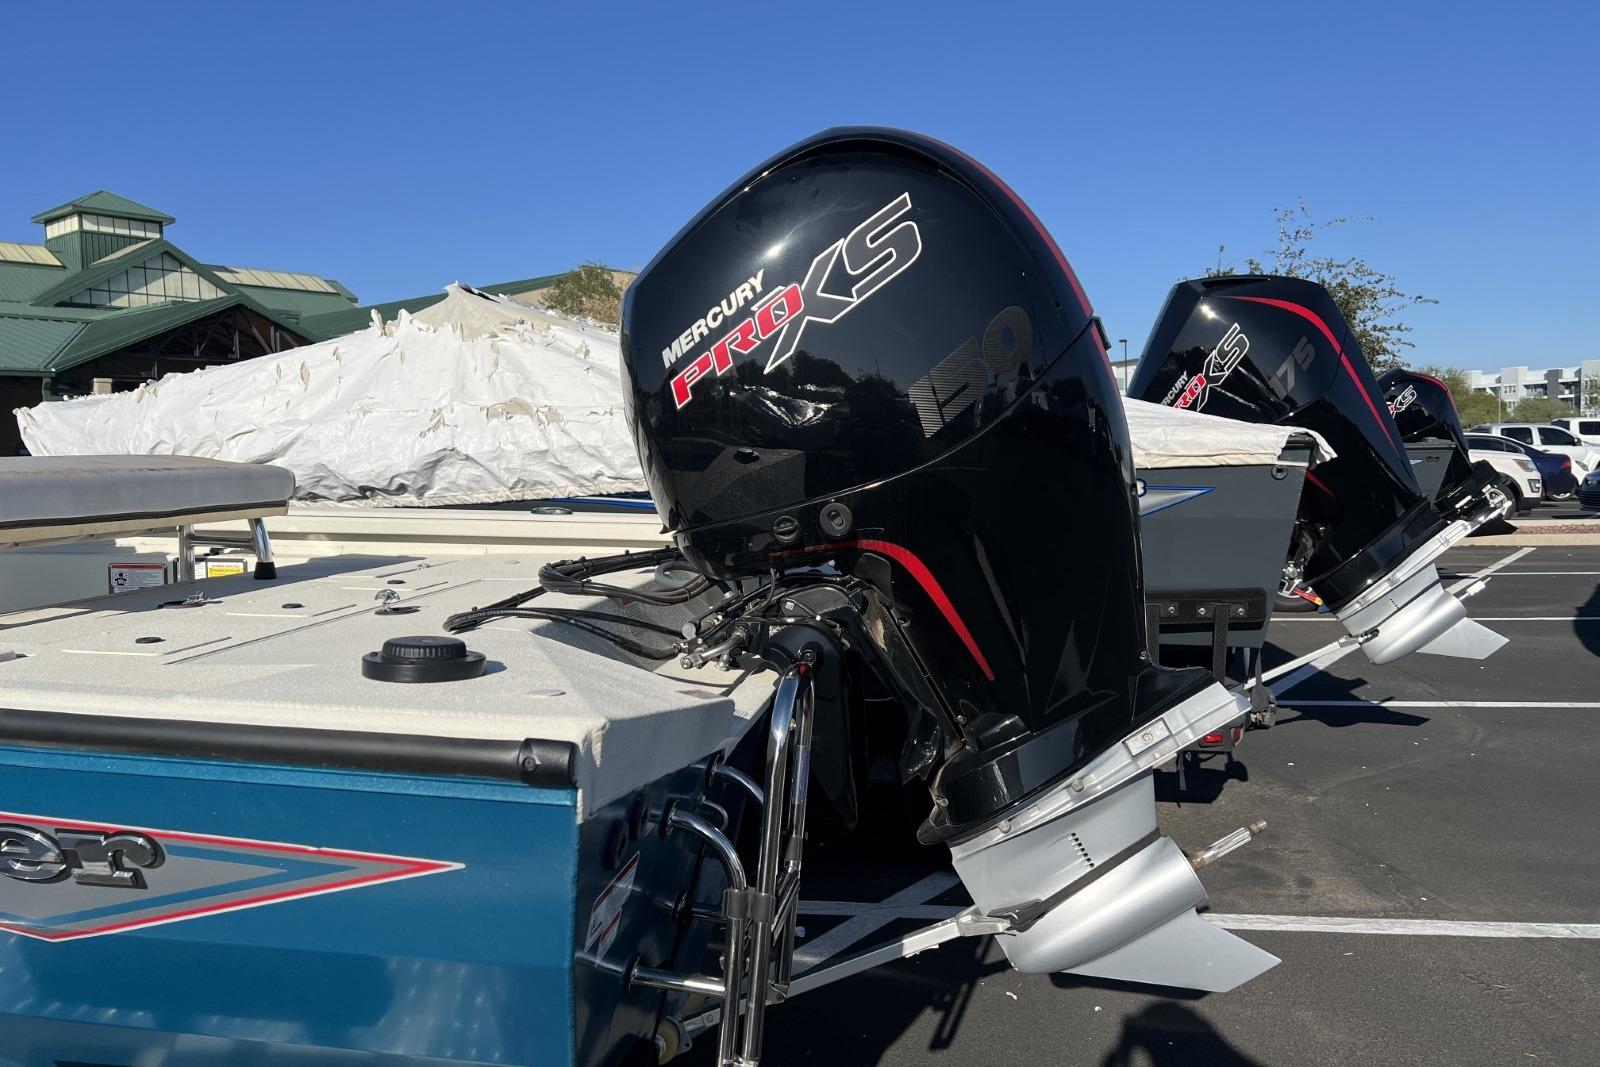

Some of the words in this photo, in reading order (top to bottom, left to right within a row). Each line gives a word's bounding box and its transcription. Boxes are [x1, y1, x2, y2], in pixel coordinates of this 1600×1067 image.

[661, 268, 765, 369] MERCURY
[670, 283, 804, 410] PRO
[763, 191, 923, 375] XS
[907, 305, 1033, 438] 150
[1160, 369, 1188, 407] RCURY
[1172, 373, 1207, 409] RO
[1196, 322, 1250, 412] XS
[1269, 335, 1316, 400] 175
